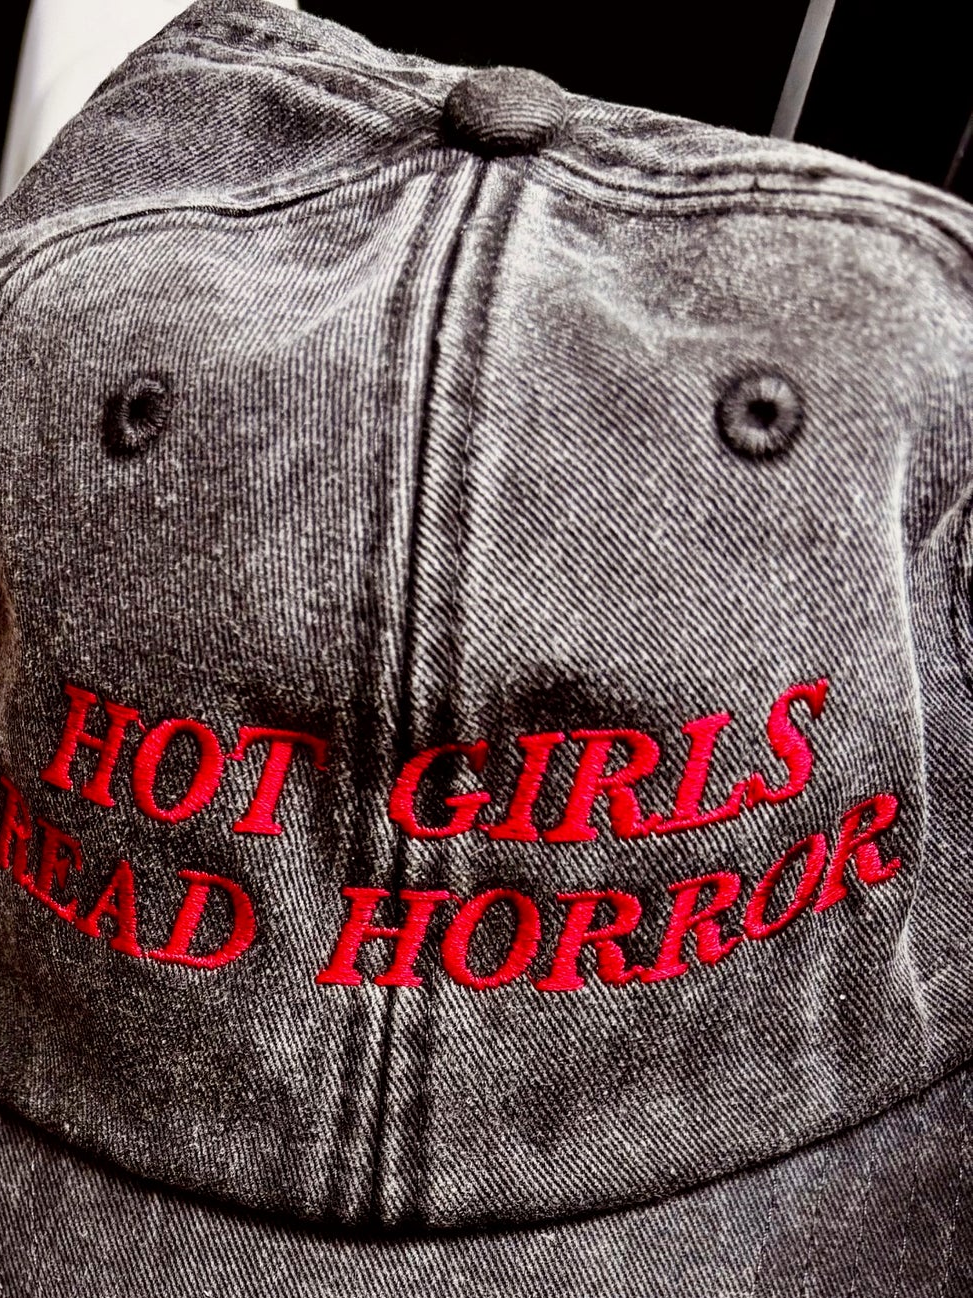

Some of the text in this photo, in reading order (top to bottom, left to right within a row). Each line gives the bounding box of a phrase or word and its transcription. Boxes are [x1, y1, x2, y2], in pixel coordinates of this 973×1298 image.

[40, 678, 828, 843] HOT GIRLS
[315, 794, 901, 992] HORROR
